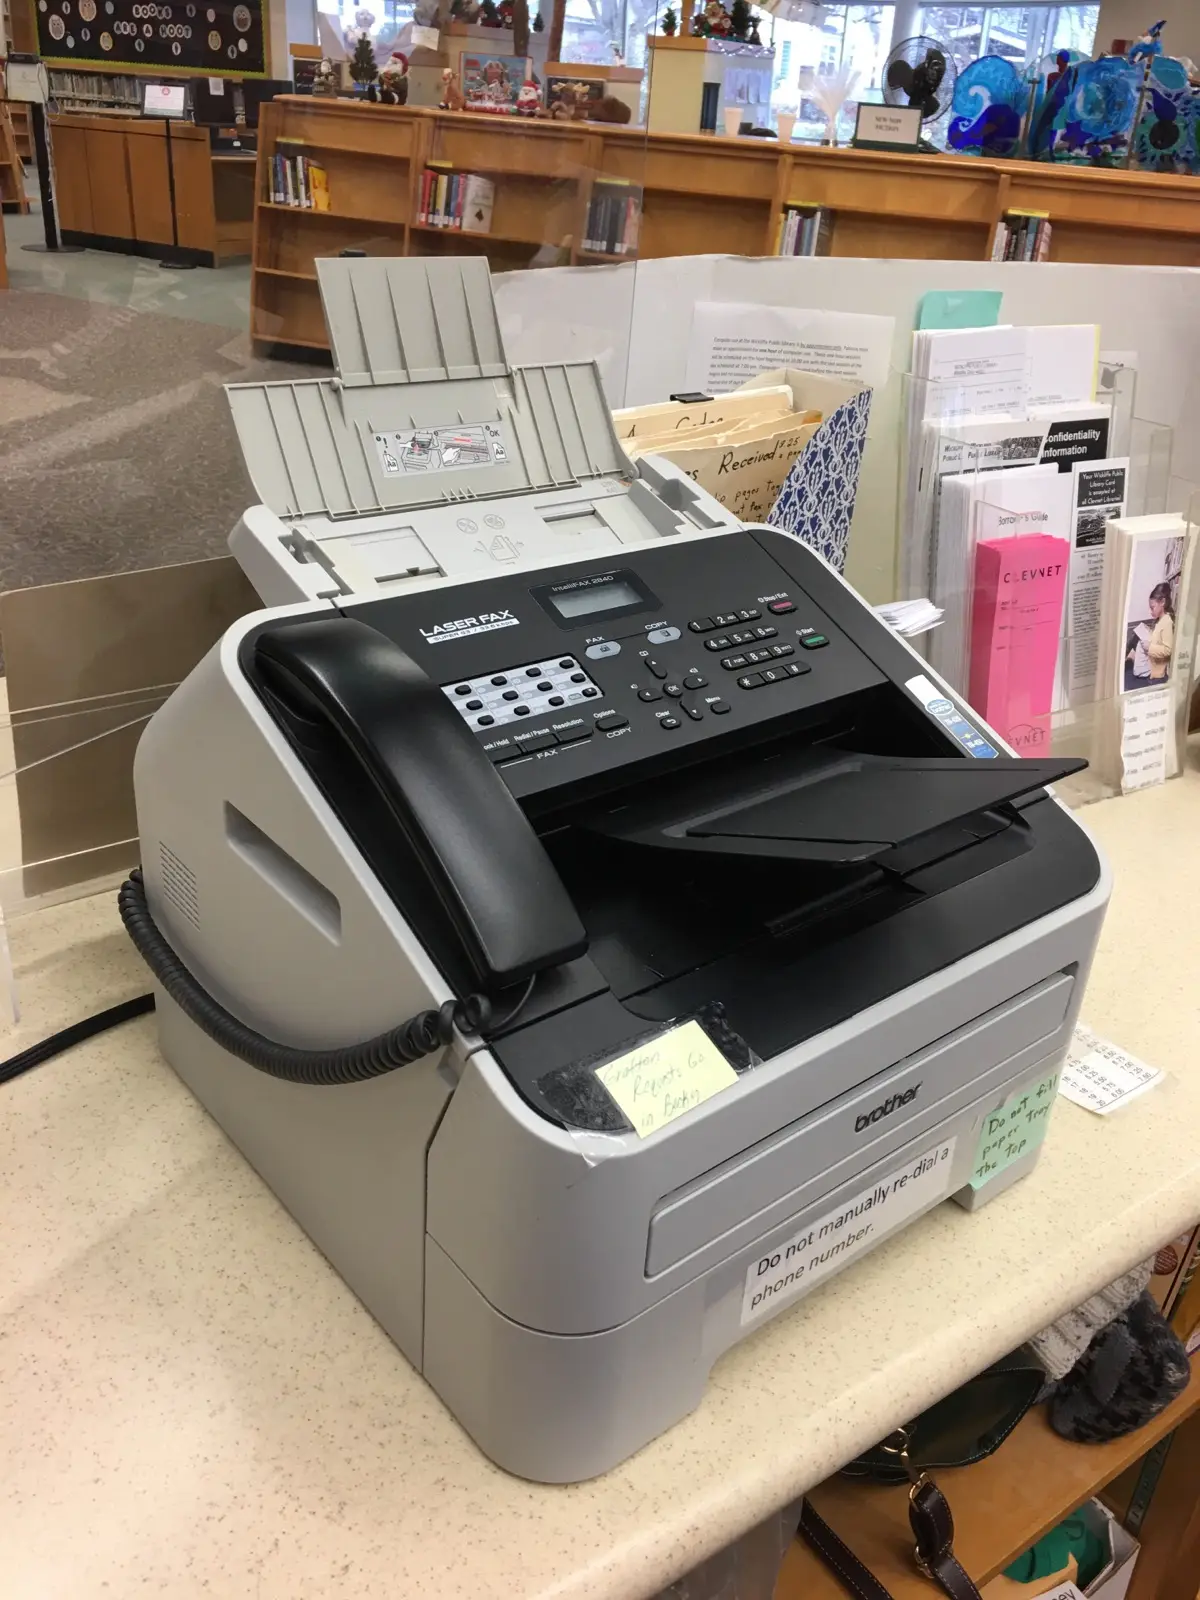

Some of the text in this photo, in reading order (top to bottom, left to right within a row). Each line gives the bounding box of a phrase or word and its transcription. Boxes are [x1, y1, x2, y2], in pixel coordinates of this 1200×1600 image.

[114, 22, 192, 38] ARE A HOOT
[718, 440, 780, 475] Received
[734, 487, 759, 504] pages
[591, 575, 614, 585] 2840
[1004, 564, 1061, 584] CEVNET
[763, 592, 788, 602] Stop/Exit
[418, 610, 514, 638] LASER FAX
[644, 620, 668, 630] COPY
[717, 616, 726, 624] 2
[433, 631, 459, 642] SUPER
[585, 636, 605, 645] FAX
[593, 709, 616, 719] Options
[484, 738, 510, 750] ook/Hold
[552, 717, 584, 730] Resolution
[606, 727, 632, 739] COPY
[536, 749, 558, 760] FAX
[854, 1080, 923, 1133] brother
[988, 1118, 1006, 1136] Do
[1036, 1074, 1058, 1098] fill
[982, 1125, 1019, 1160] paper
[757, 1148, 949, 1276] Do not manually re-dial a
[751, 1222, 874, 1310] phone number.
